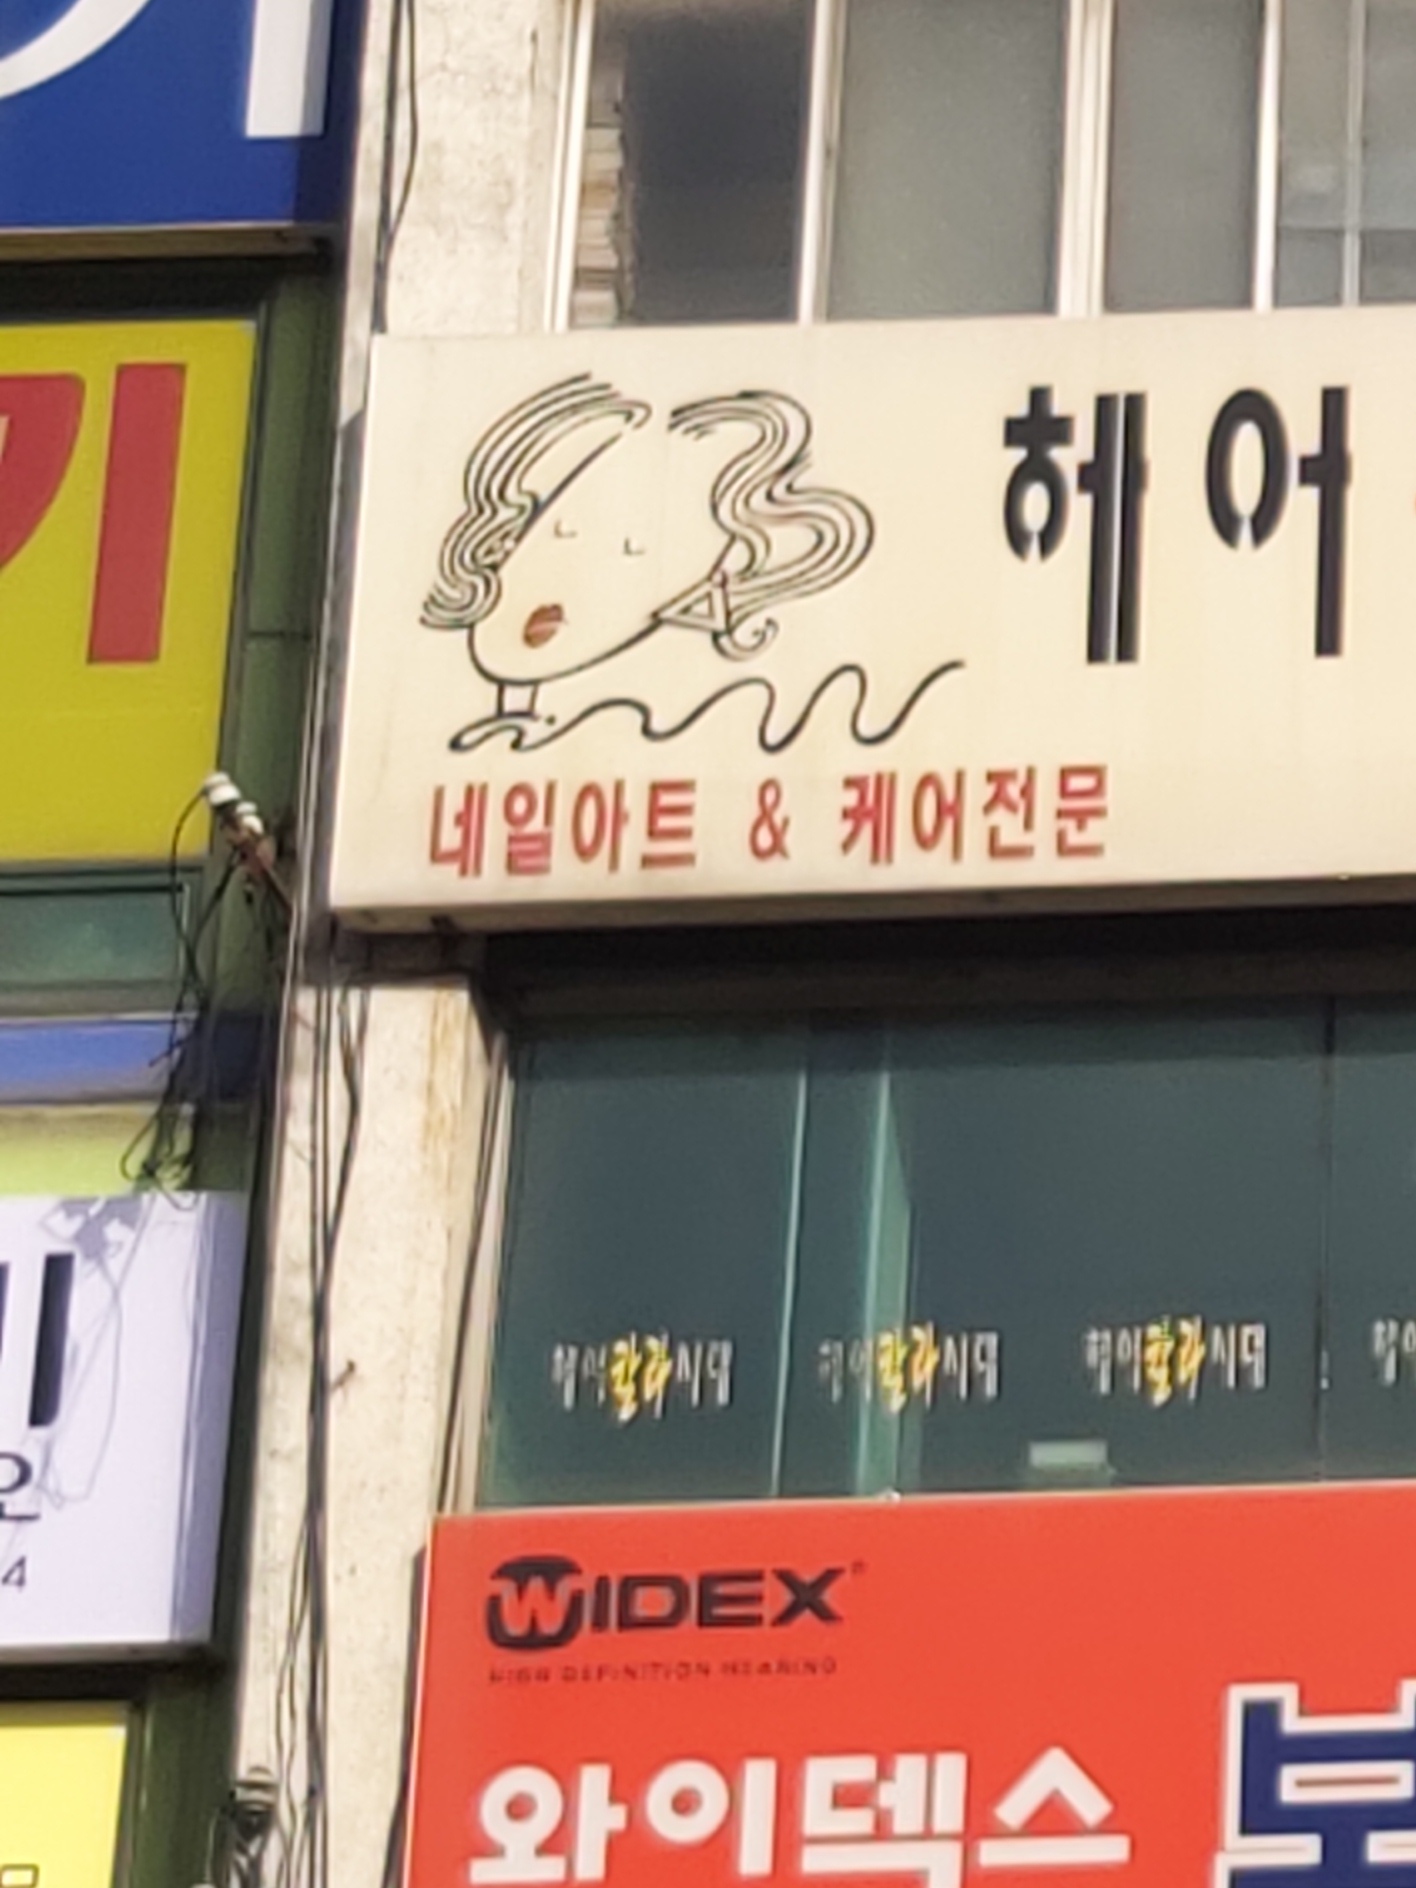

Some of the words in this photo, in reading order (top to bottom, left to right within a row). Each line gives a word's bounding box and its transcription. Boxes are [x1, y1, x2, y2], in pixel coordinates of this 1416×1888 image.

[428, 779, 697, 877] 네일아트
[750, 779, 790, 861] &
[841, 765, 1108, 866] 케어전문
[486, 1554, 850, 1652] WIDEX
